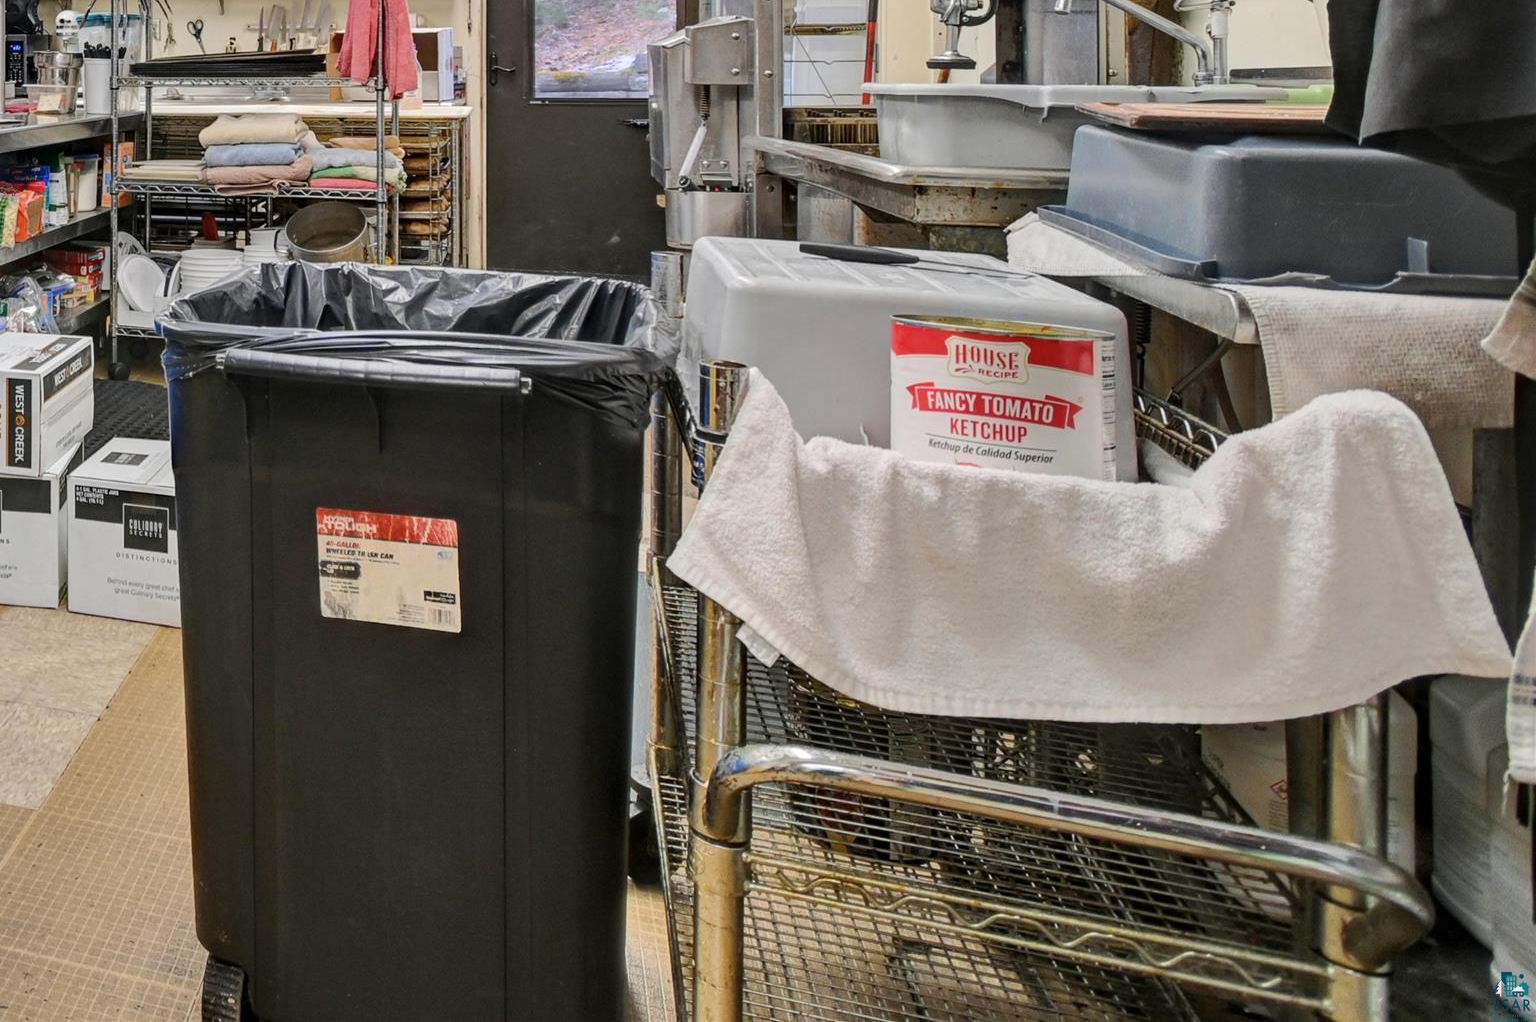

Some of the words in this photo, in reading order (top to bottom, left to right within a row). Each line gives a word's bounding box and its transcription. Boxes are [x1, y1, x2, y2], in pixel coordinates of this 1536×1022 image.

[955, 344, 1020, 371] HOUSE
[54, 368, 66, 387] WEST
[70, 356, 83, 376] CREEK
[977, 368, 1019, 379] RECIPE
[14, 384, 25, 415] WEST
[926, 390, 980, 414] FANCY
[981, 396, 1054, 424] TOMATO
[949, 417, 1028, 444] KETCHUP
[14, 428, 25, 464] CREEK
[928, 438, 961, 454] Ketchup
[962, 444, 974, 455] de
[975, 446, 1012, 460] Calidad
[1013, 451, 1054, 464] Superior
[128, 518, 163, 533] CULINARY
[128, 529, 163, 539] SECRETS
[115, 552, 177, 566] DISTINCTIONS
